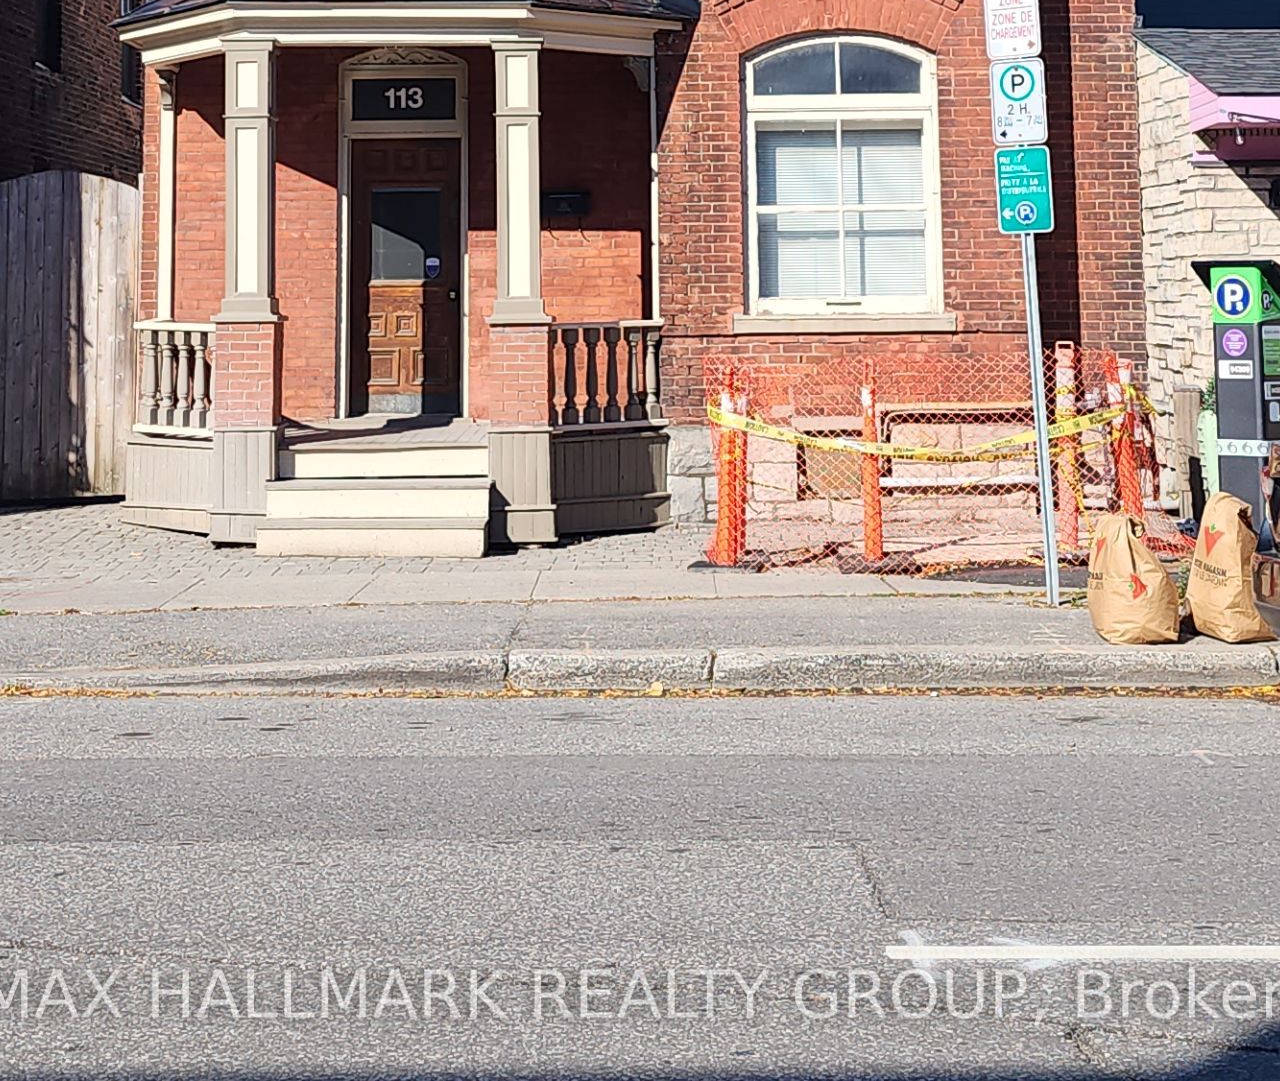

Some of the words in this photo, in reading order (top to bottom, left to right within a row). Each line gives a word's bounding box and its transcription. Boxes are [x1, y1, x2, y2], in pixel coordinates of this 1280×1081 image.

[991, 11, 1017, 26] ZONE
[1020, 9, 1034, 24] DE
[384, 87, 424, 109] 113
